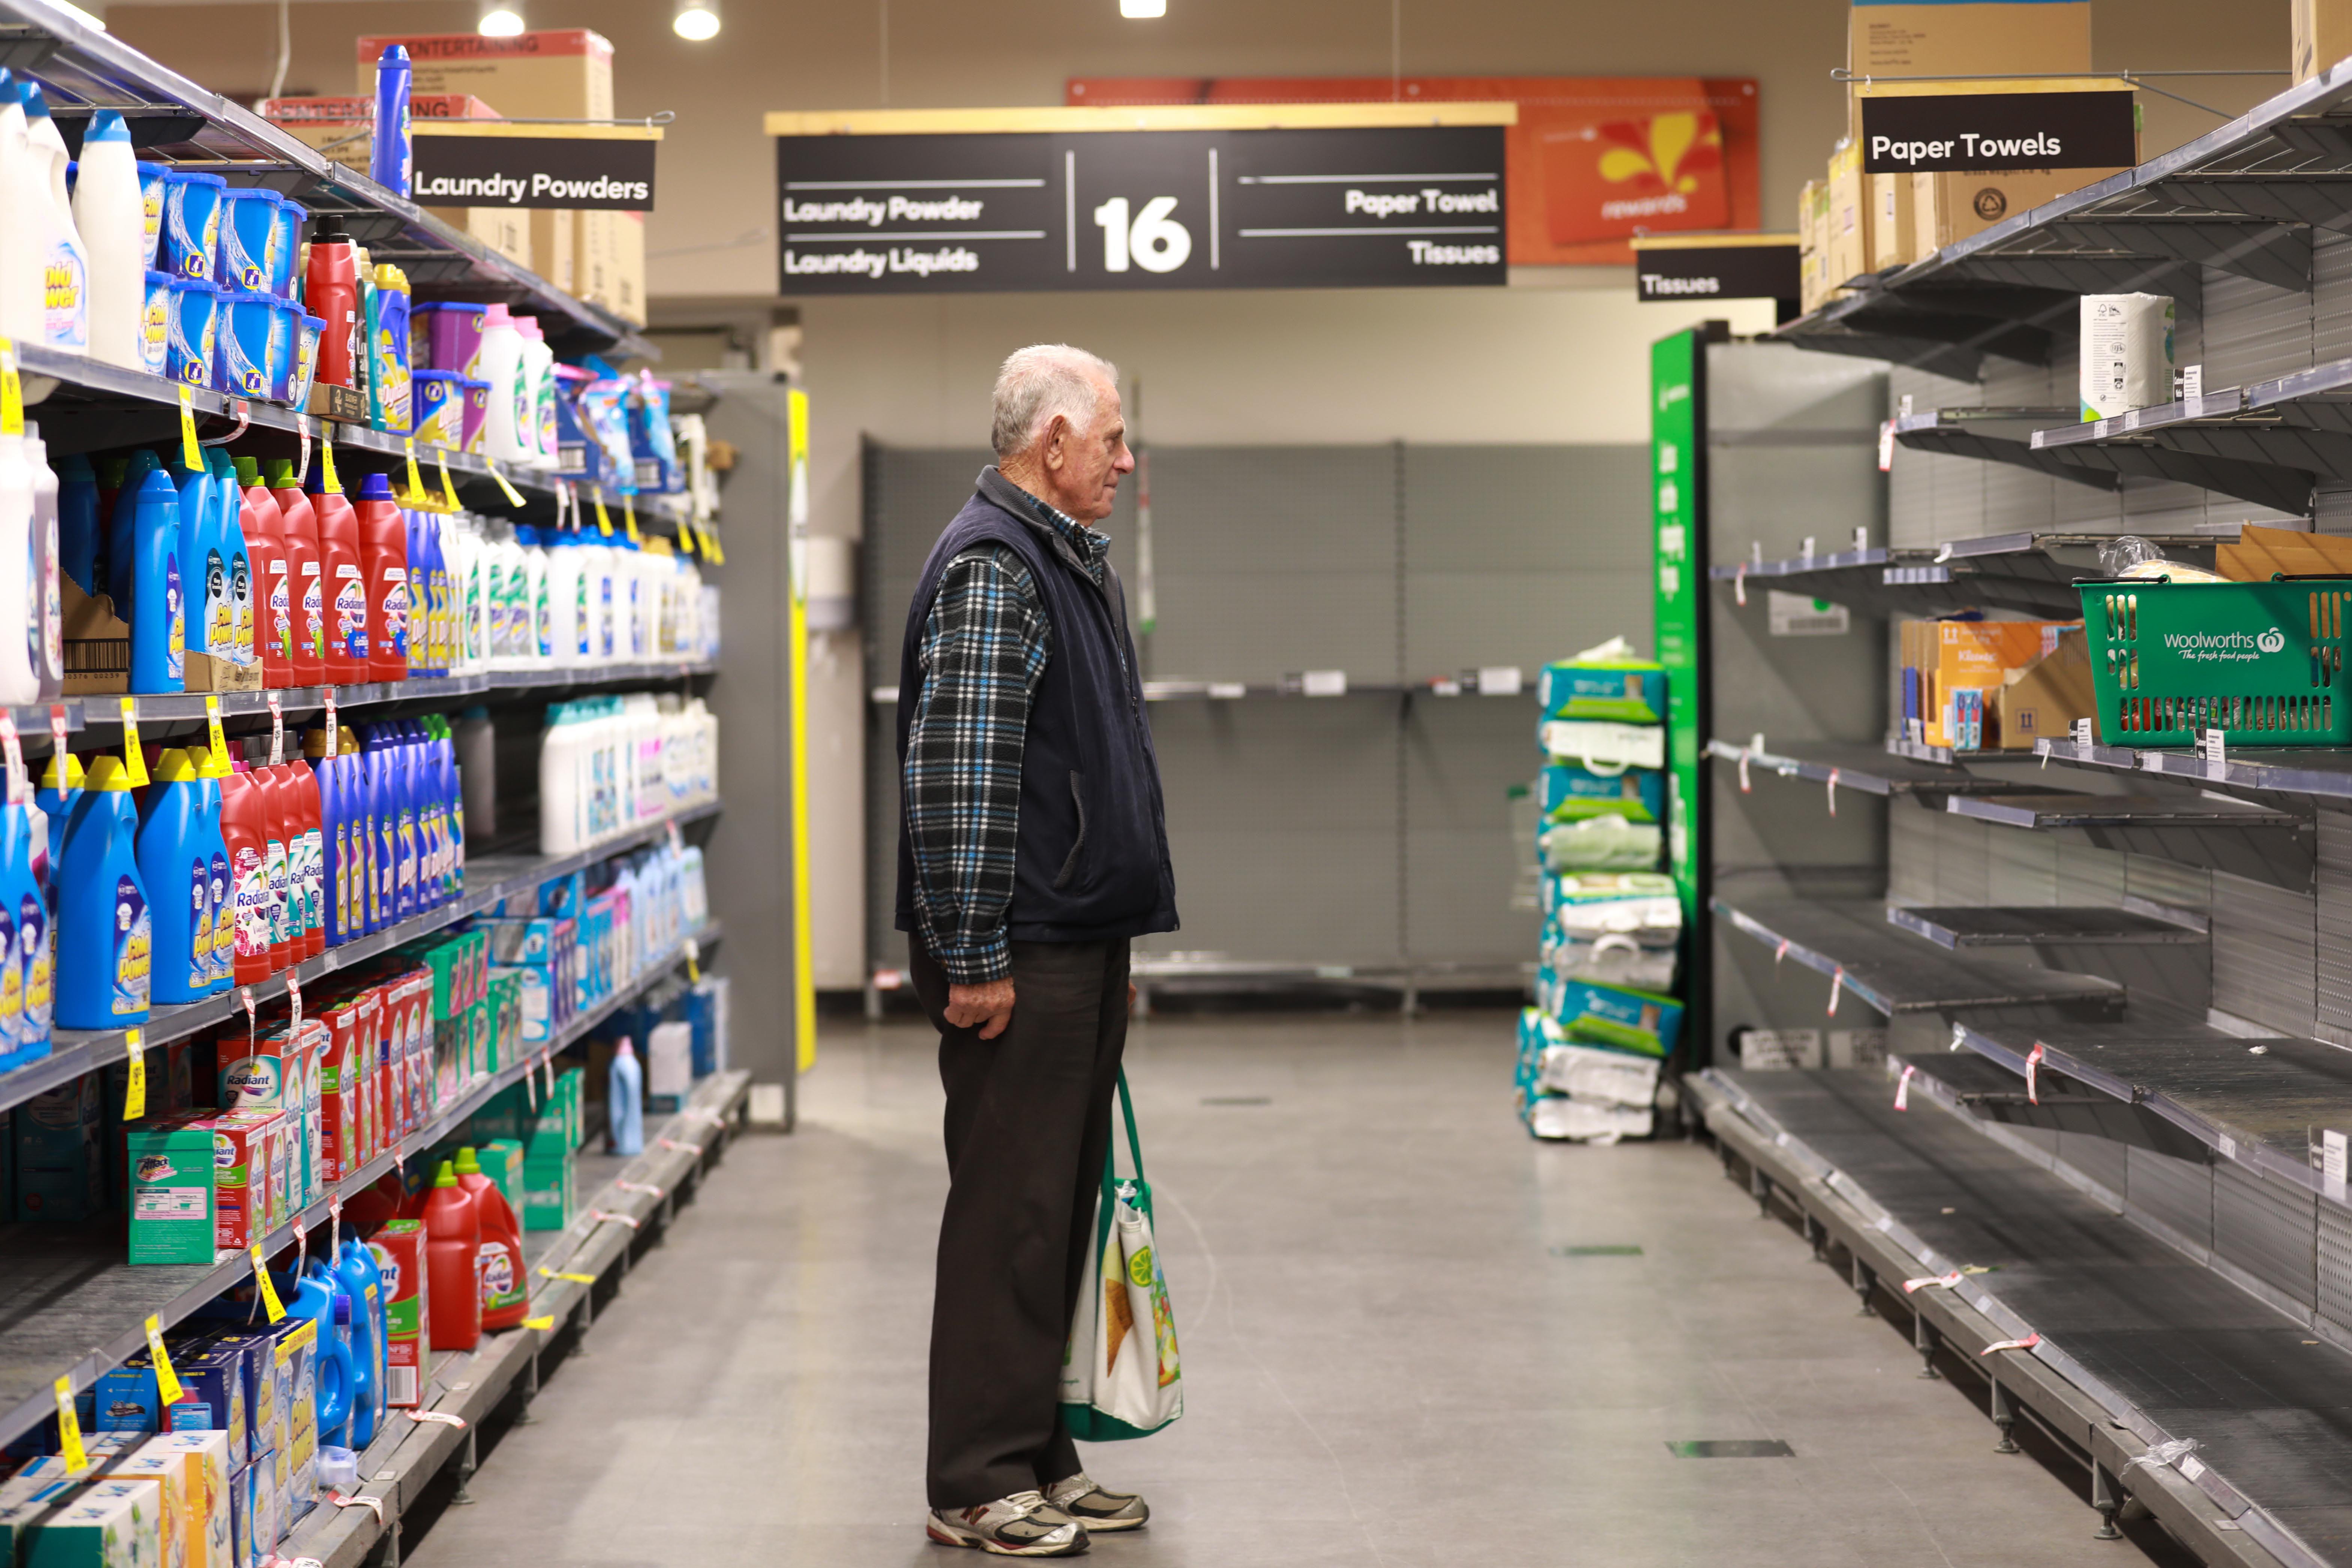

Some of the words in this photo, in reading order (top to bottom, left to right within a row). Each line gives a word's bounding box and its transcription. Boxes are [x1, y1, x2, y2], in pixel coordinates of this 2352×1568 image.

[1872, 136, 1954, 165] Paper
[1960, 132, 2061, 158] Towels
[415, 171, 526, 203] Laundry
[532, 173, 649, 201] Powders
[783, 196, 887, 227] Laundry
[888, 195, 984, 221] Powder
[1346, 189, 1420, 218] Paper
[1421, 188, 1499, 213] Towel
[1094, 196, 1193, 274] 16
[784, 248, 888, 278] Laundry
[888, 246, 979, 278] Liquids
[1407, 239, 1500, 265] Tissues
[45, 261, 73, 288] old
[1641, 274, 1720, 294] Tissues
[45, 286, 79, 309] wer
[2164, 631, 2254, 648] Woolworths
[2178, 649, 2196, 659] The
[2197, 650, 2217, 662] fresh
[2219, 650, 2235, 662] food
[2236, 651, 2260, 662] people
[227, 1075, 269, 1085] Radiant
[215, 1147, 235, 1155] iant
